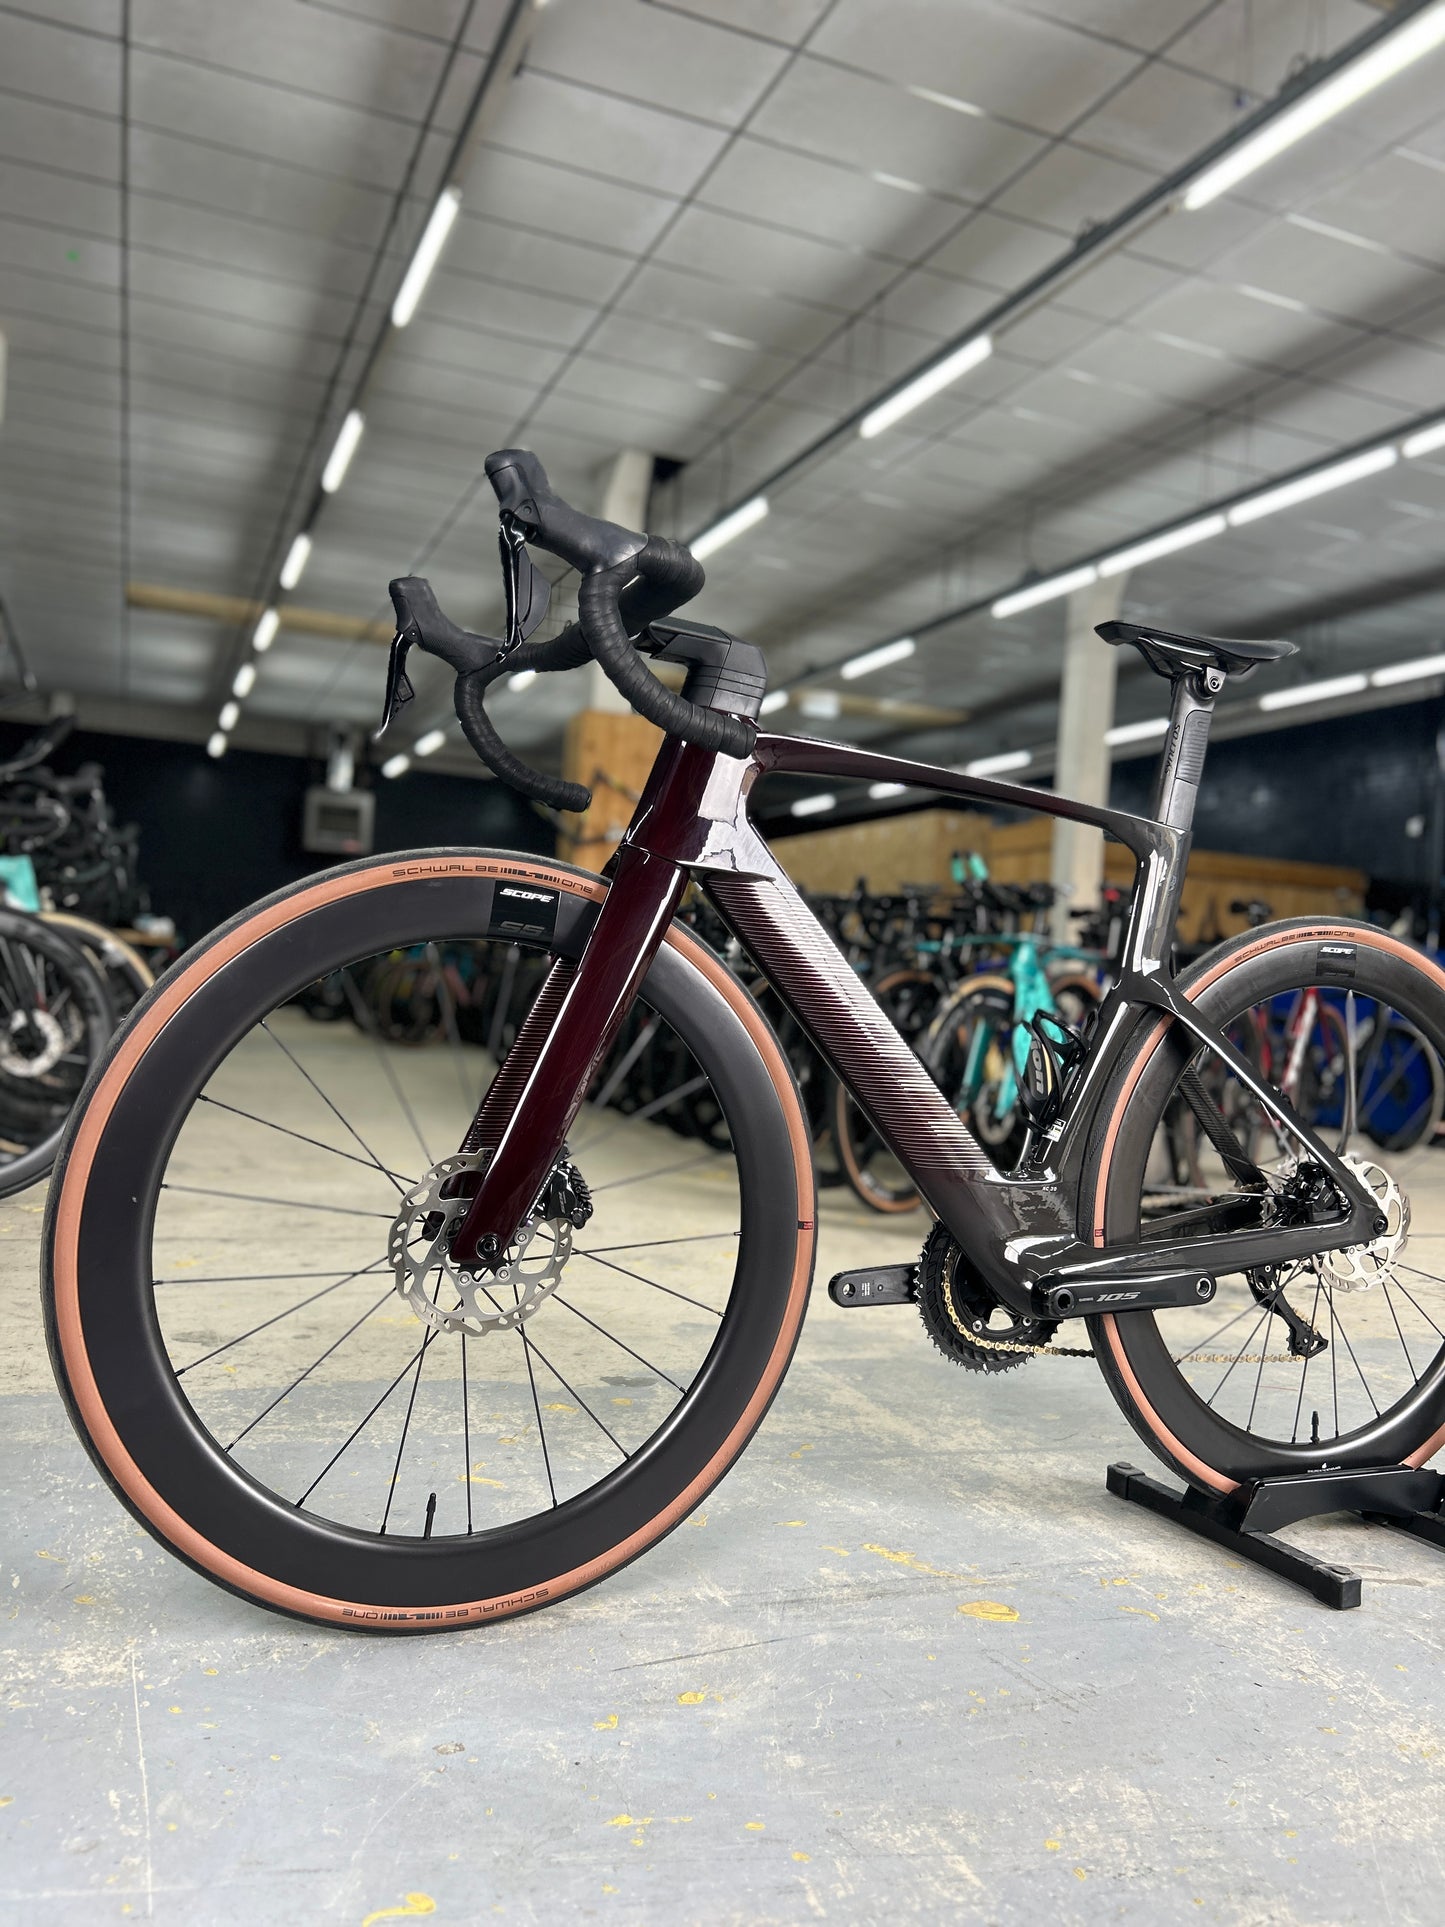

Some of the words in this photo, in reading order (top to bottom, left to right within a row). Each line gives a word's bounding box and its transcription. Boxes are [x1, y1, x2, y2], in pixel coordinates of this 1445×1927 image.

[392, 864, 499, 878] SCHWALBE
[499, 888, 555, 903] SCOPE
[1234, 933, 1296, 963] SCHWALBE
[1320, 946, 1354, 955] SCOPE
[1096, 1291, 1141, 1302] 105
[445, 1588, 550, 1619] SCHWALBE
